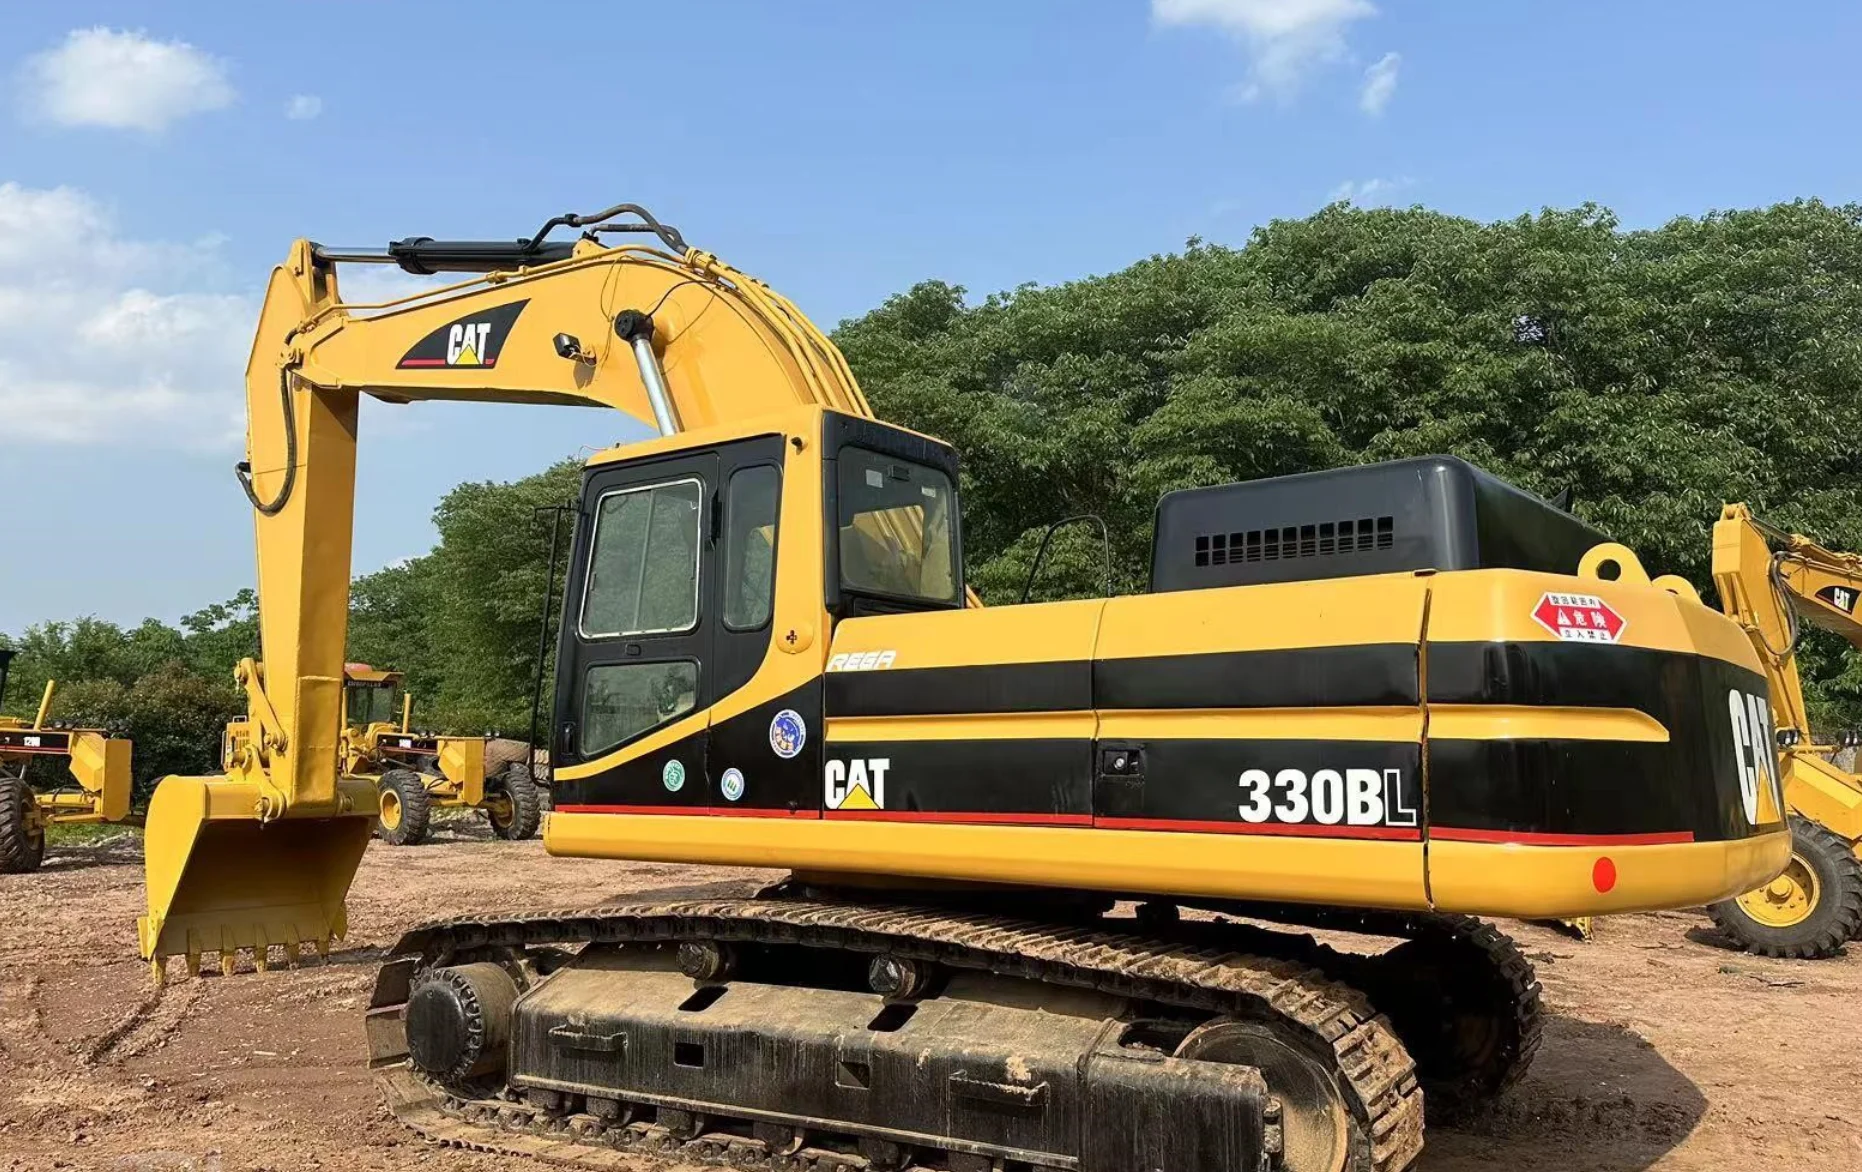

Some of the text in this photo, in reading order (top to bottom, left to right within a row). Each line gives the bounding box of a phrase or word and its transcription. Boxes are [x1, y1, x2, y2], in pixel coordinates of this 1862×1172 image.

[447, 323, 491, 365] CAT
[1834, 587, 1850, 611] CAT
[1729, 688, 1780, 825] CAT
[824, 758, 890, 810] CAT
[1238, 768, 1417, 826] 330BL
